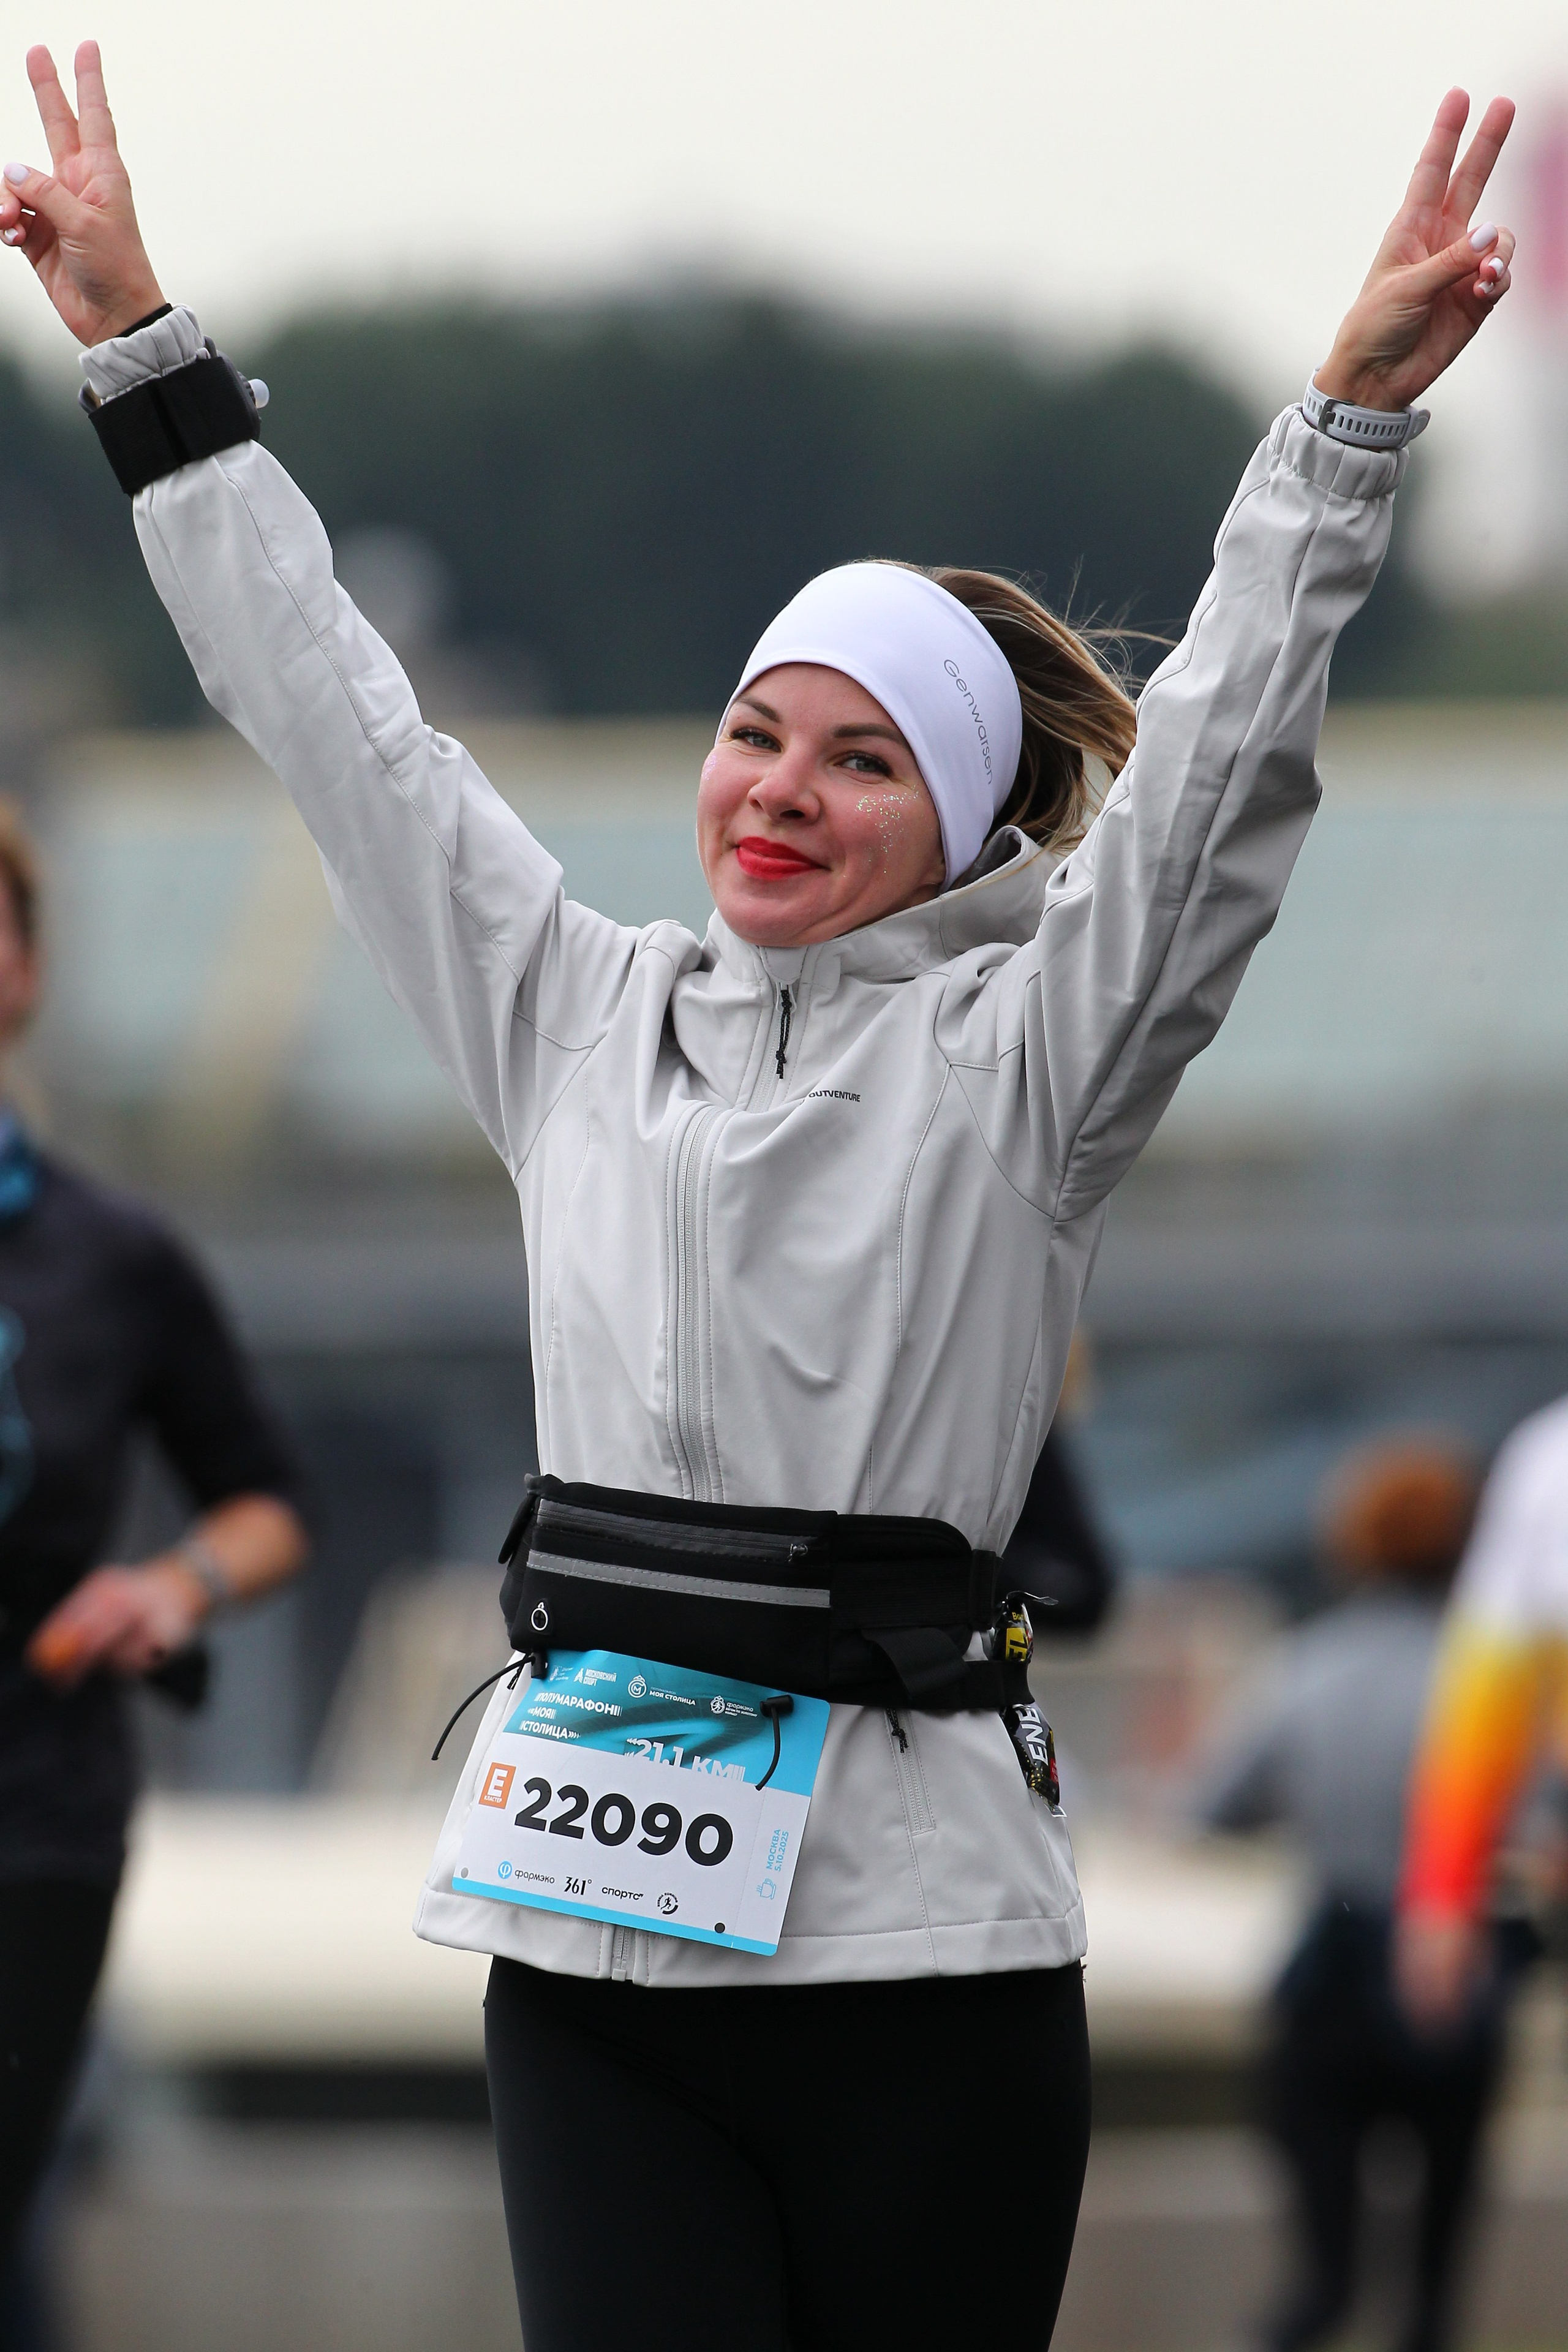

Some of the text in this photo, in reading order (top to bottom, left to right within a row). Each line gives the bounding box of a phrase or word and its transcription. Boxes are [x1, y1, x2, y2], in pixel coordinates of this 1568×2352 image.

[944, 660, 993, 785] Genwarsen
[809, 1090, 861, 1102] OUTVENTURE
[585, 1668, 617, 1682] МОСКОВСКИЙ
[665, 1694, 696, 1705] СТОЛИЦА
[635, 1739, 684, 1768] 21.1
[514, 1776, 733, 1866] 22090
[766, 1829, 781, 1869] МОСКВА
[774, 1831, 789, 1872] 5.10.2025
[514, 1869, 555, 1884] фармэко
